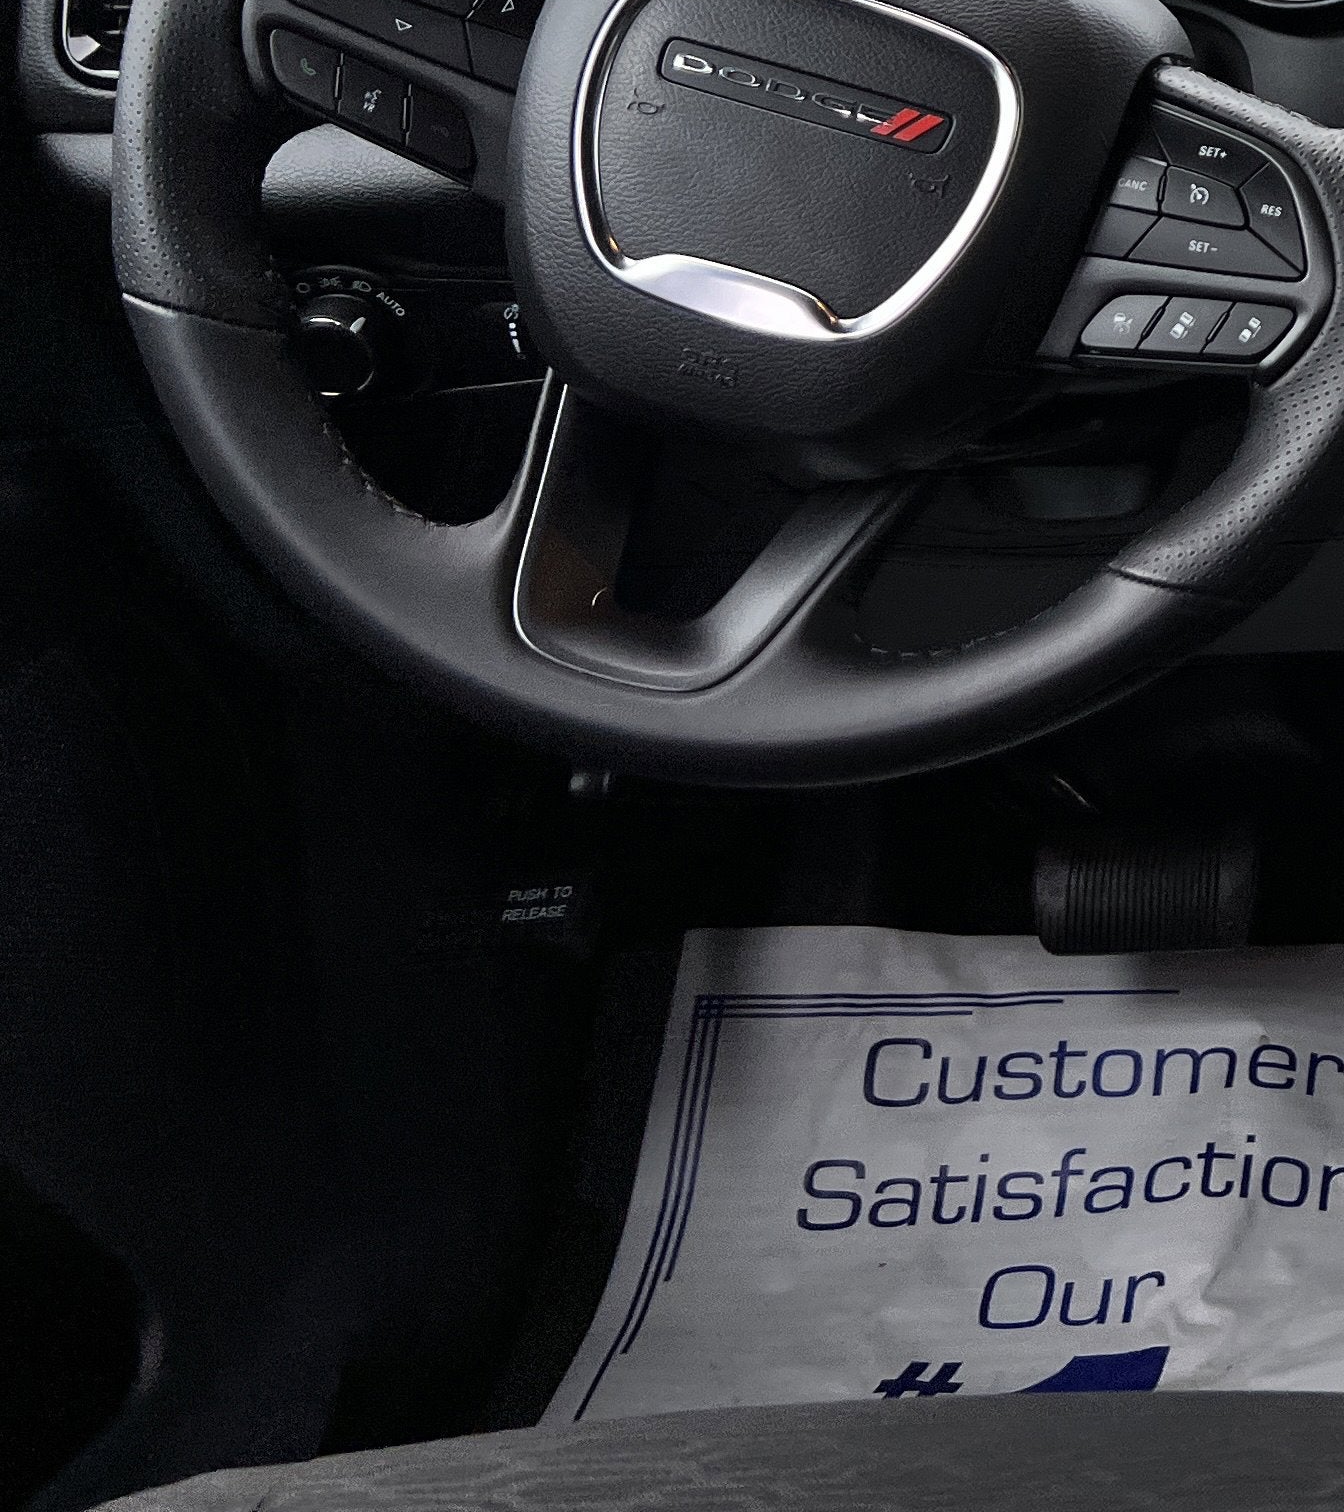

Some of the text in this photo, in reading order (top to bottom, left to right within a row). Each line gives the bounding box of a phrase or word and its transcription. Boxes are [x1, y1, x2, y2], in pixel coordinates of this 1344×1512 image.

[672, 53, 896, 127] DODGE
[1197, 144, 1228, 159] SET+
[1116, 177, 1149, 192] CANC
[1259, 203, 1283, 218] RES
[1187, 239, 1219, 253] SET-
[375, 291, 406, 317] AUTO
[508, 886, 573, 903] PUSH TO
[502, 905, 567, 921] RELEASE
[976, 1264, 1170, 1331] Our
